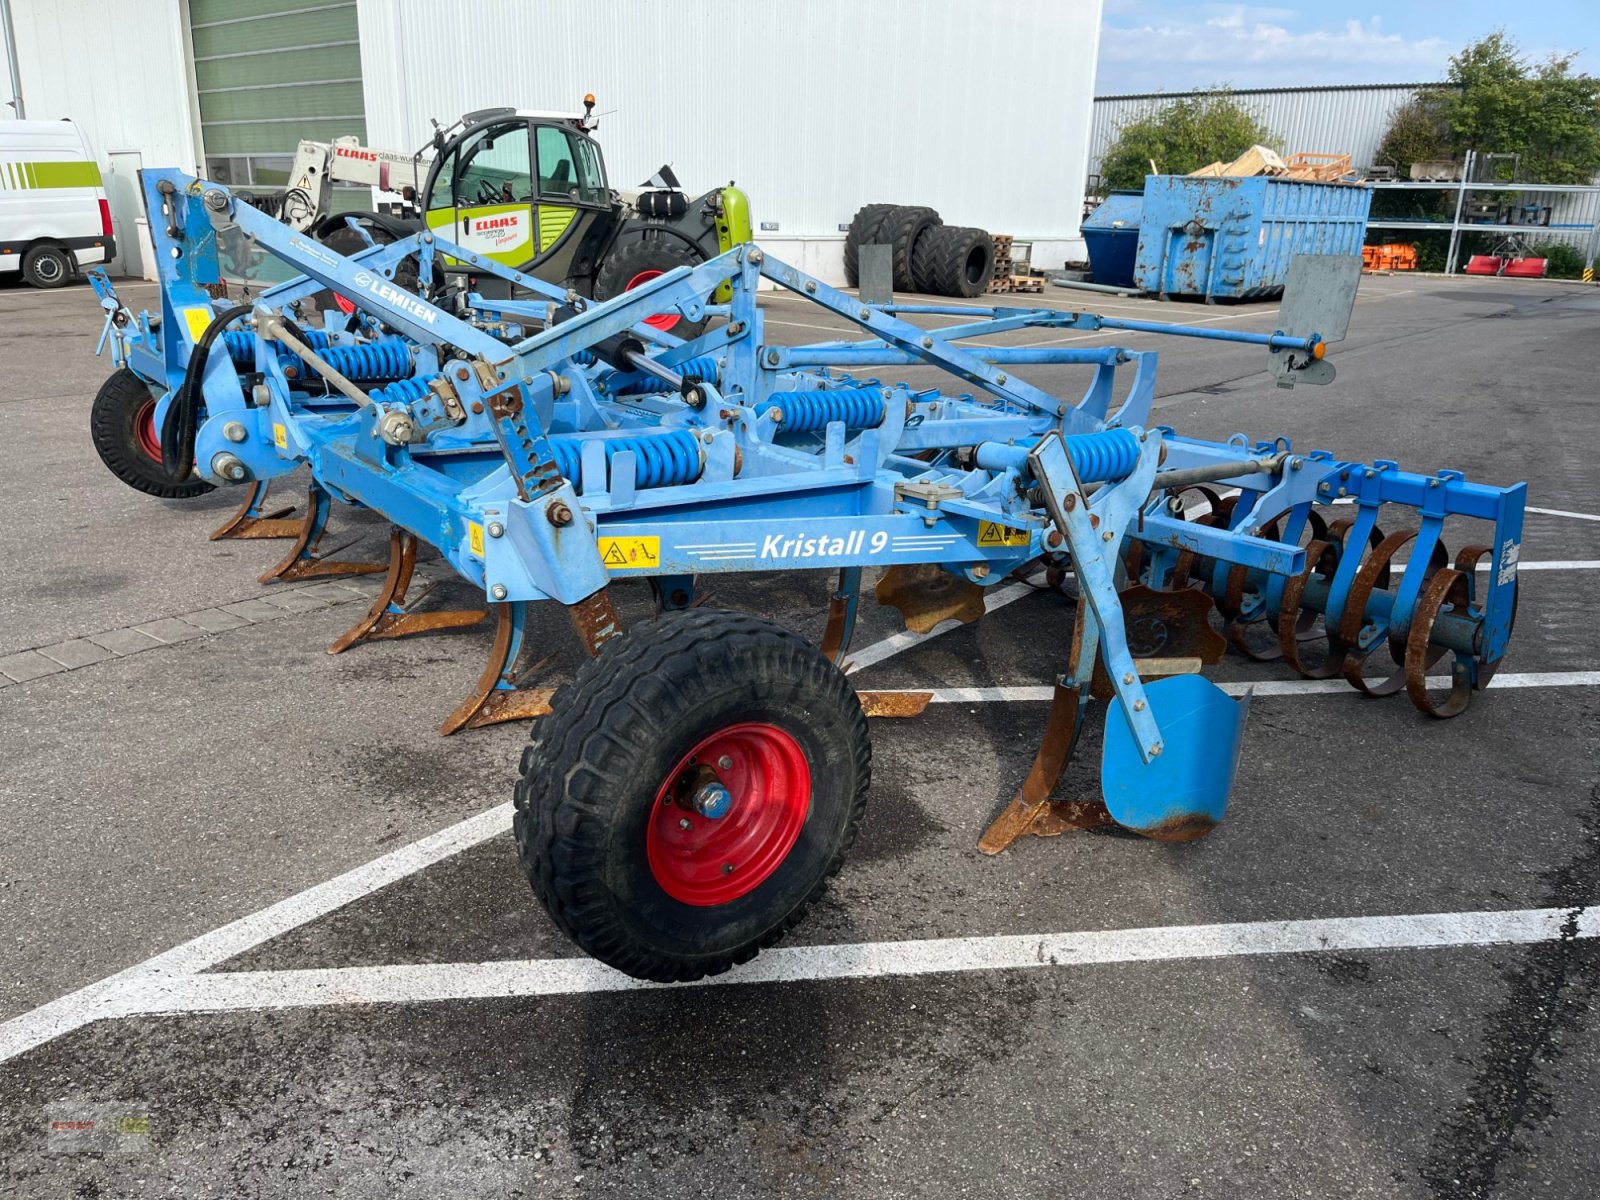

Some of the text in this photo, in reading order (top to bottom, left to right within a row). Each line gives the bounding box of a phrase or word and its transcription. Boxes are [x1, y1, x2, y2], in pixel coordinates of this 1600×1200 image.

[336, 147, 378, 162] CLAAS
[475, 216, 518, 231] CLAAS
[369, 279, 437, 324] LEMKEN
[760, 529, 889, 559] Kristall 9
